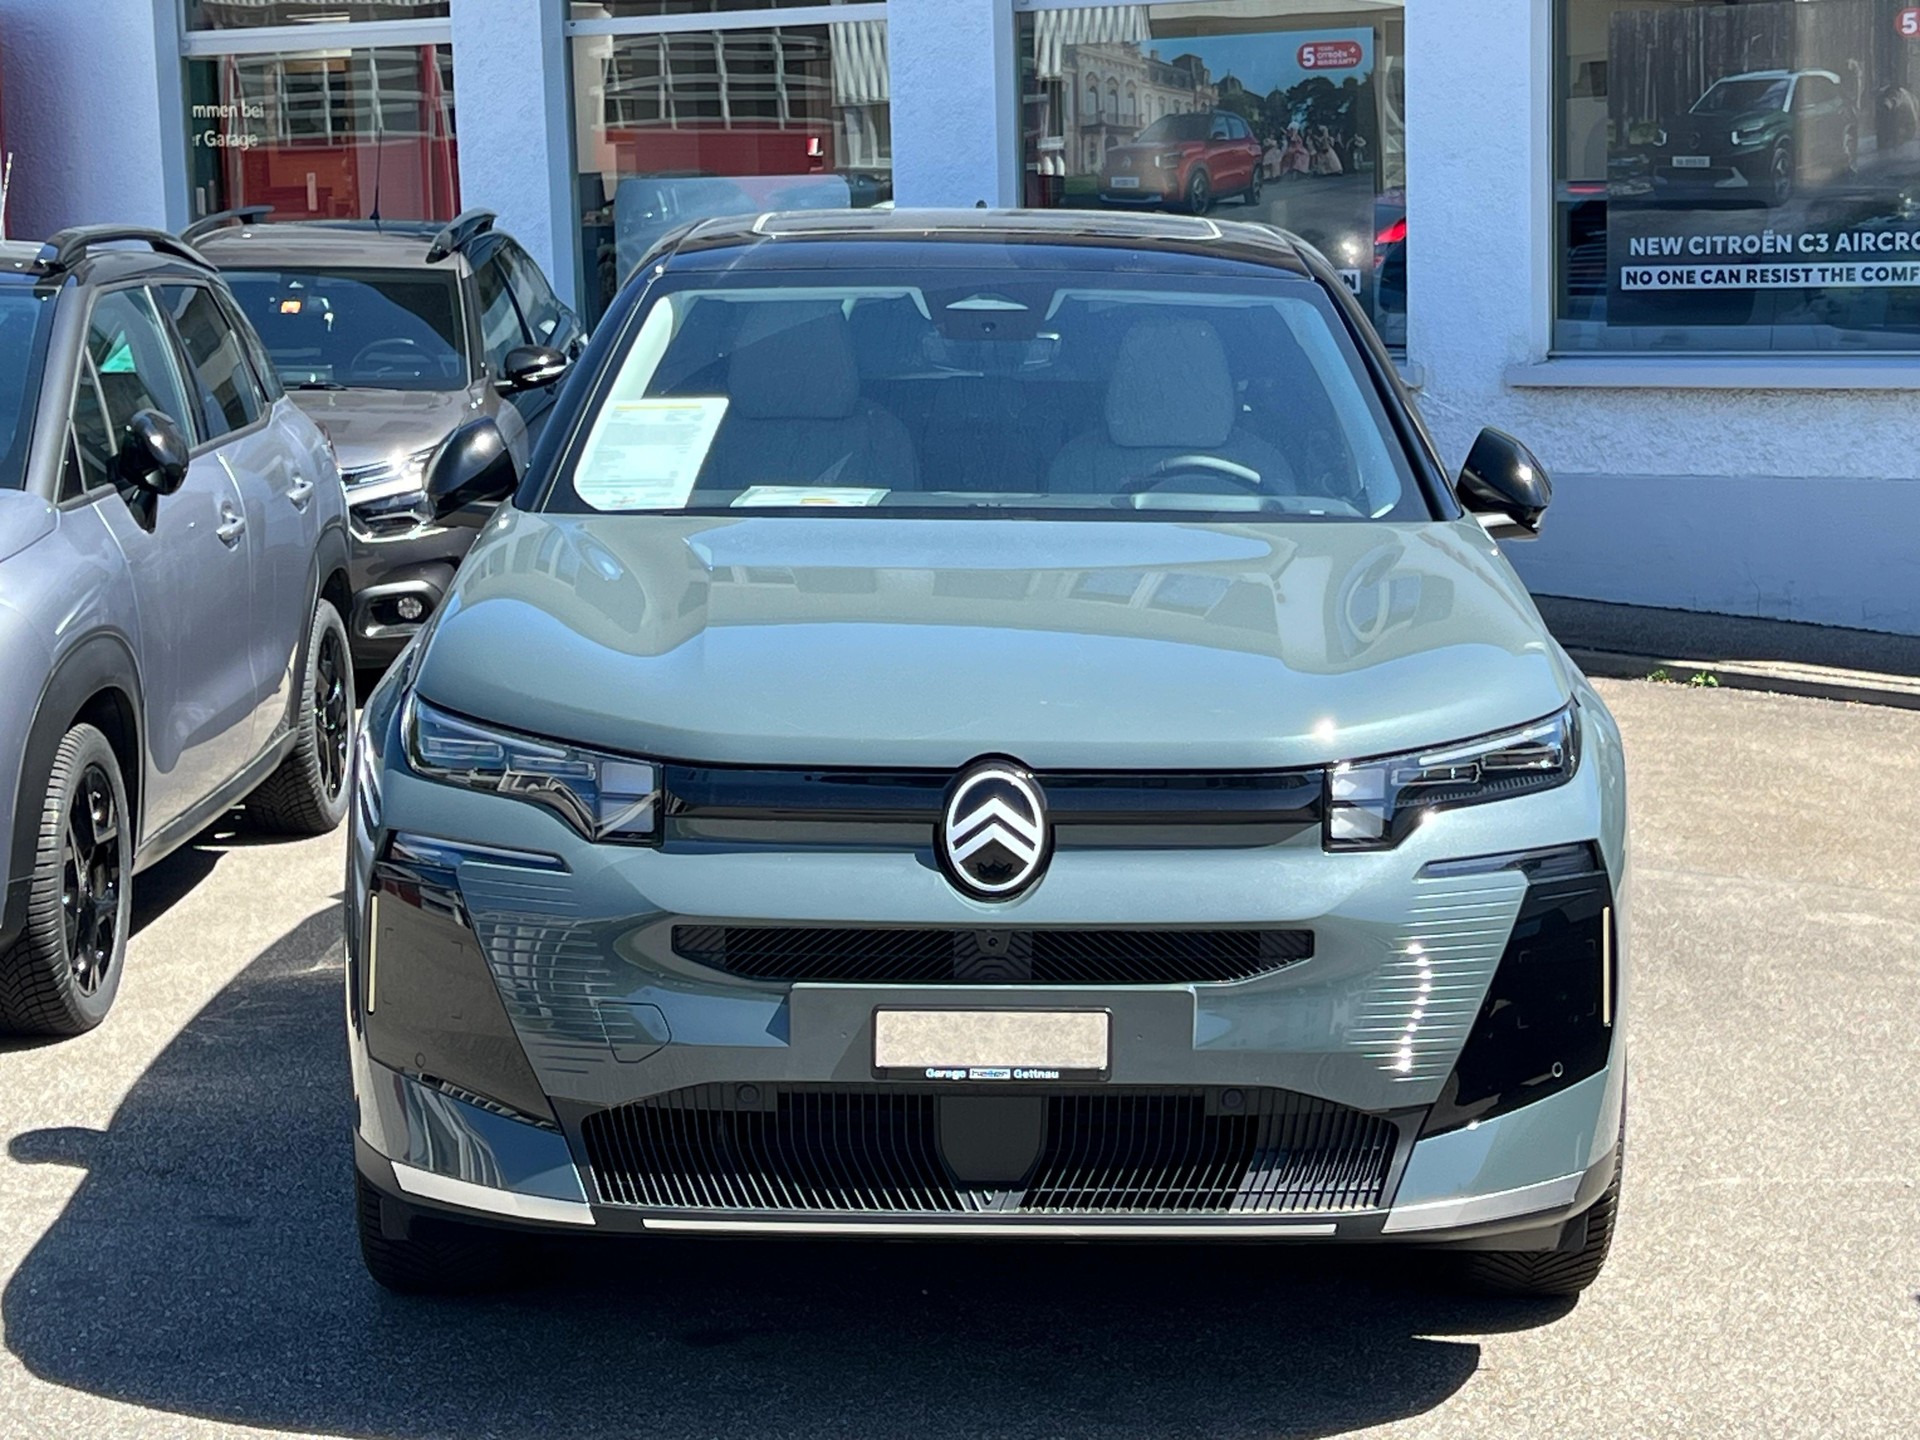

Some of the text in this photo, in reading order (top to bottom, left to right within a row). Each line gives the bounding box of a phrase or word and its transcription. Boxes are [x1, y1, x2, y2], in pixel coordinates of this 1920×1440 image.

[1901, 11, 1918, 35] 5
[1302, 47, 1315, 67] 5
[241, 99, 265, 119] bei
[203, 130, 258, 151] Garage
[1629, 236, 1684, 256] NEW
[1688, 229, 1793, 255] CITROËN
[1797, 233, 1829, 253] C3
[1625, 266, 1920, 285] NO ONE CAN RESIST THE COMF
[925, 1068, 967, 1080] Garage
[1013, 1068, 1060, 1079] Gettnau
